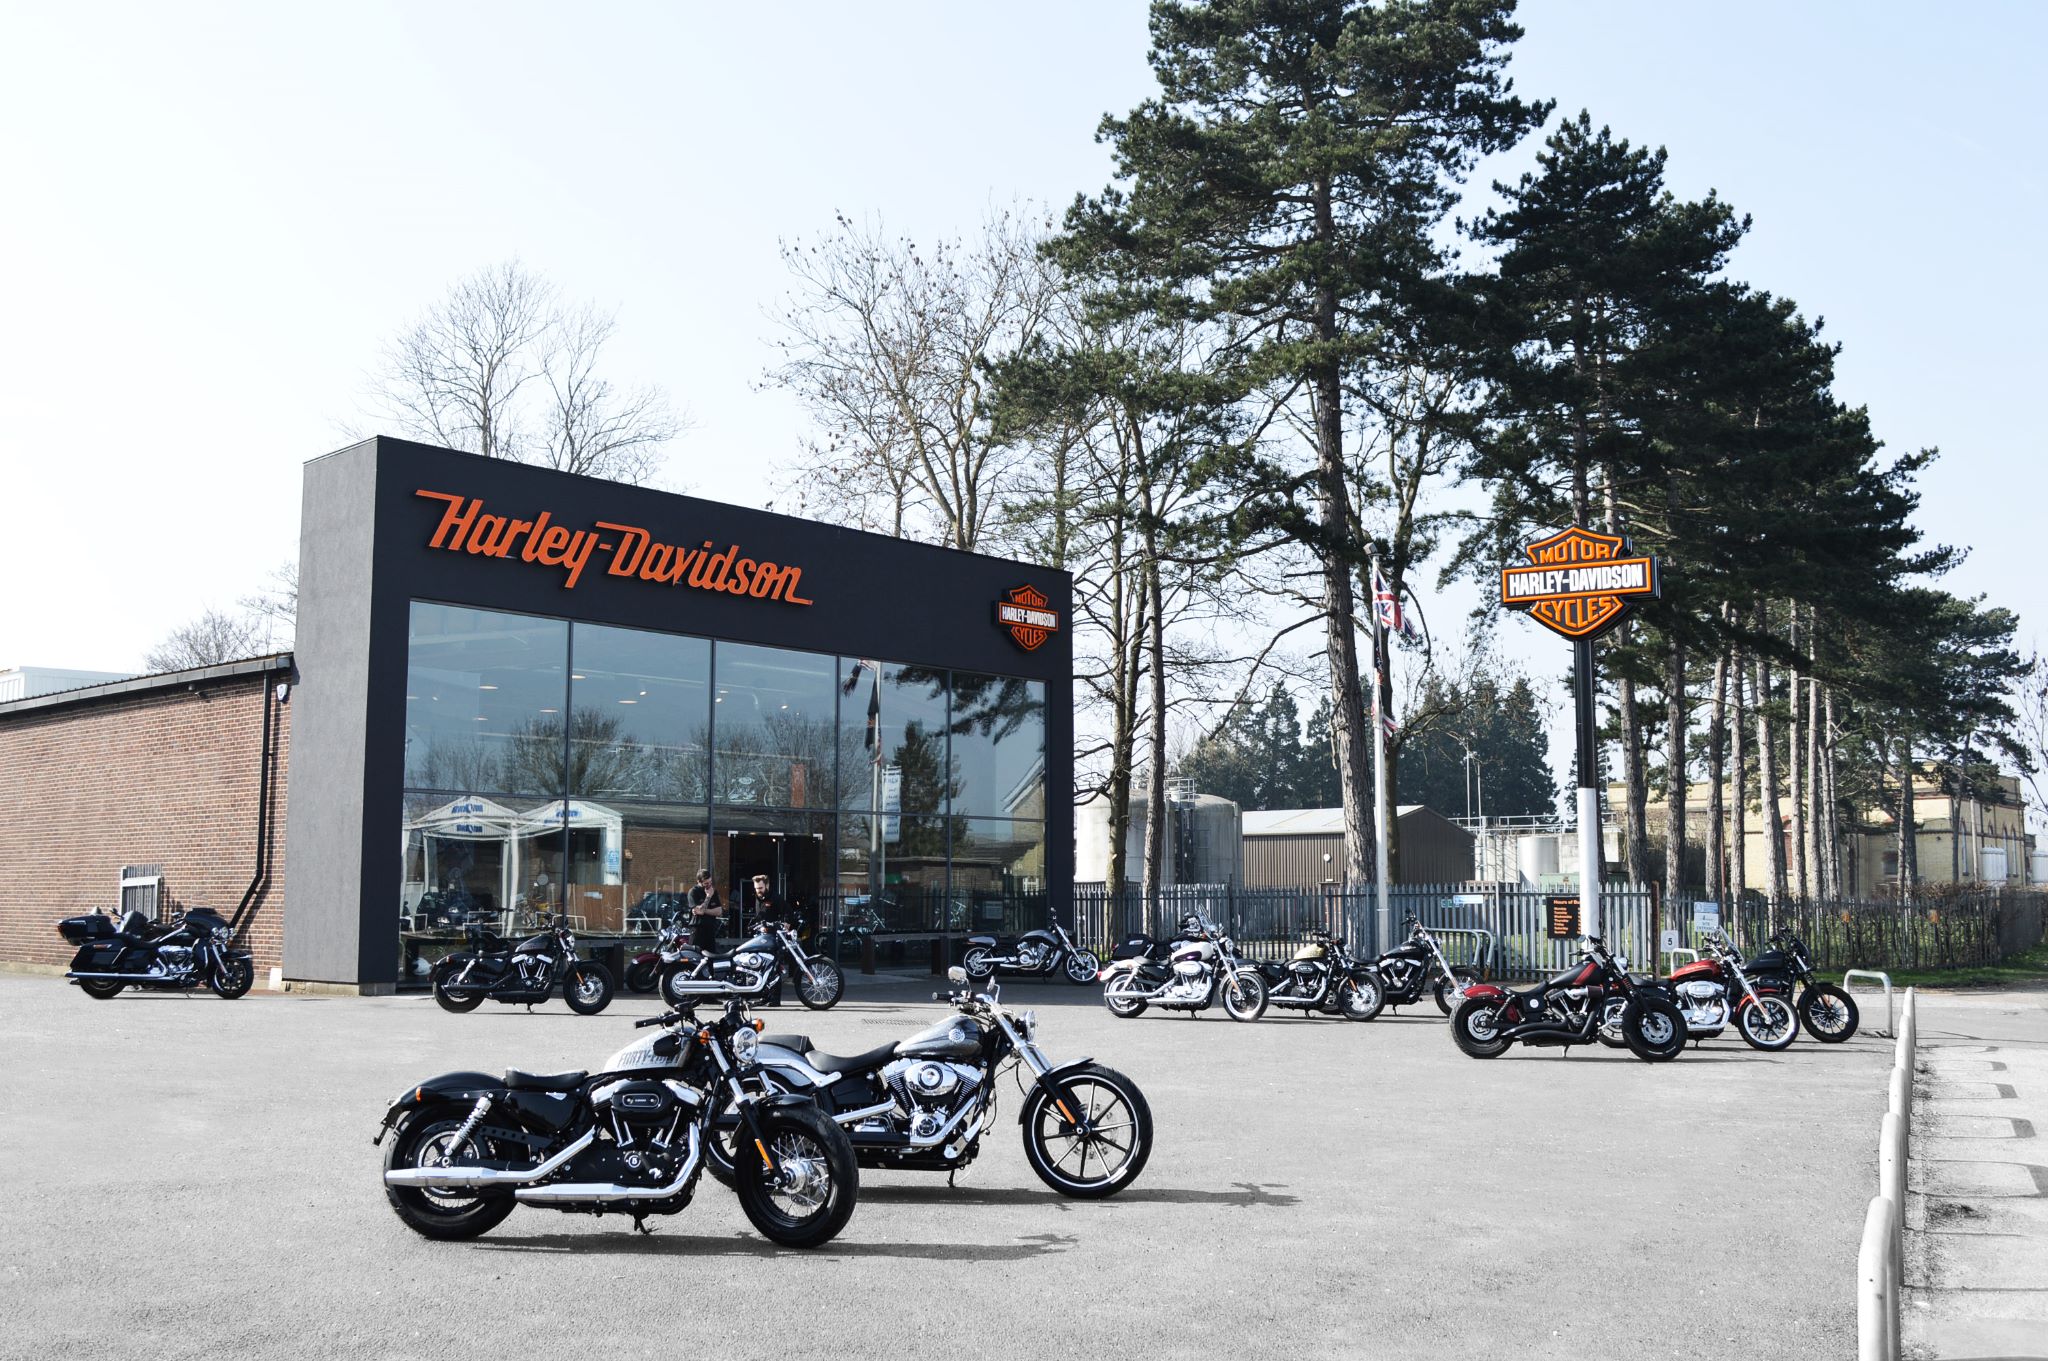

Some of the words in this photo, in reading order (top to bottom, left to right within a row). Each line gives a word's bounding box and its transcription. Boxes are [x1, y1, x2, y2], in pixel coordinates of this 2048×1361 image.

[415, 489, 814, 605] Harley-Davidson
[1539, 535, 1611, 564] MOTOR
[1509, 563, 1643, 597] HARLEY-DAVIDSON
[1015, 591, 1043, 606] MOTOR
[1002, 605, 1056, 628] HARLEY-DAVIDSON
[1540, 597, 1613, 628] CYCLES
[1014, 626, 1044, 646] CYCLES
[1667, 937, 1673, 946] 5
